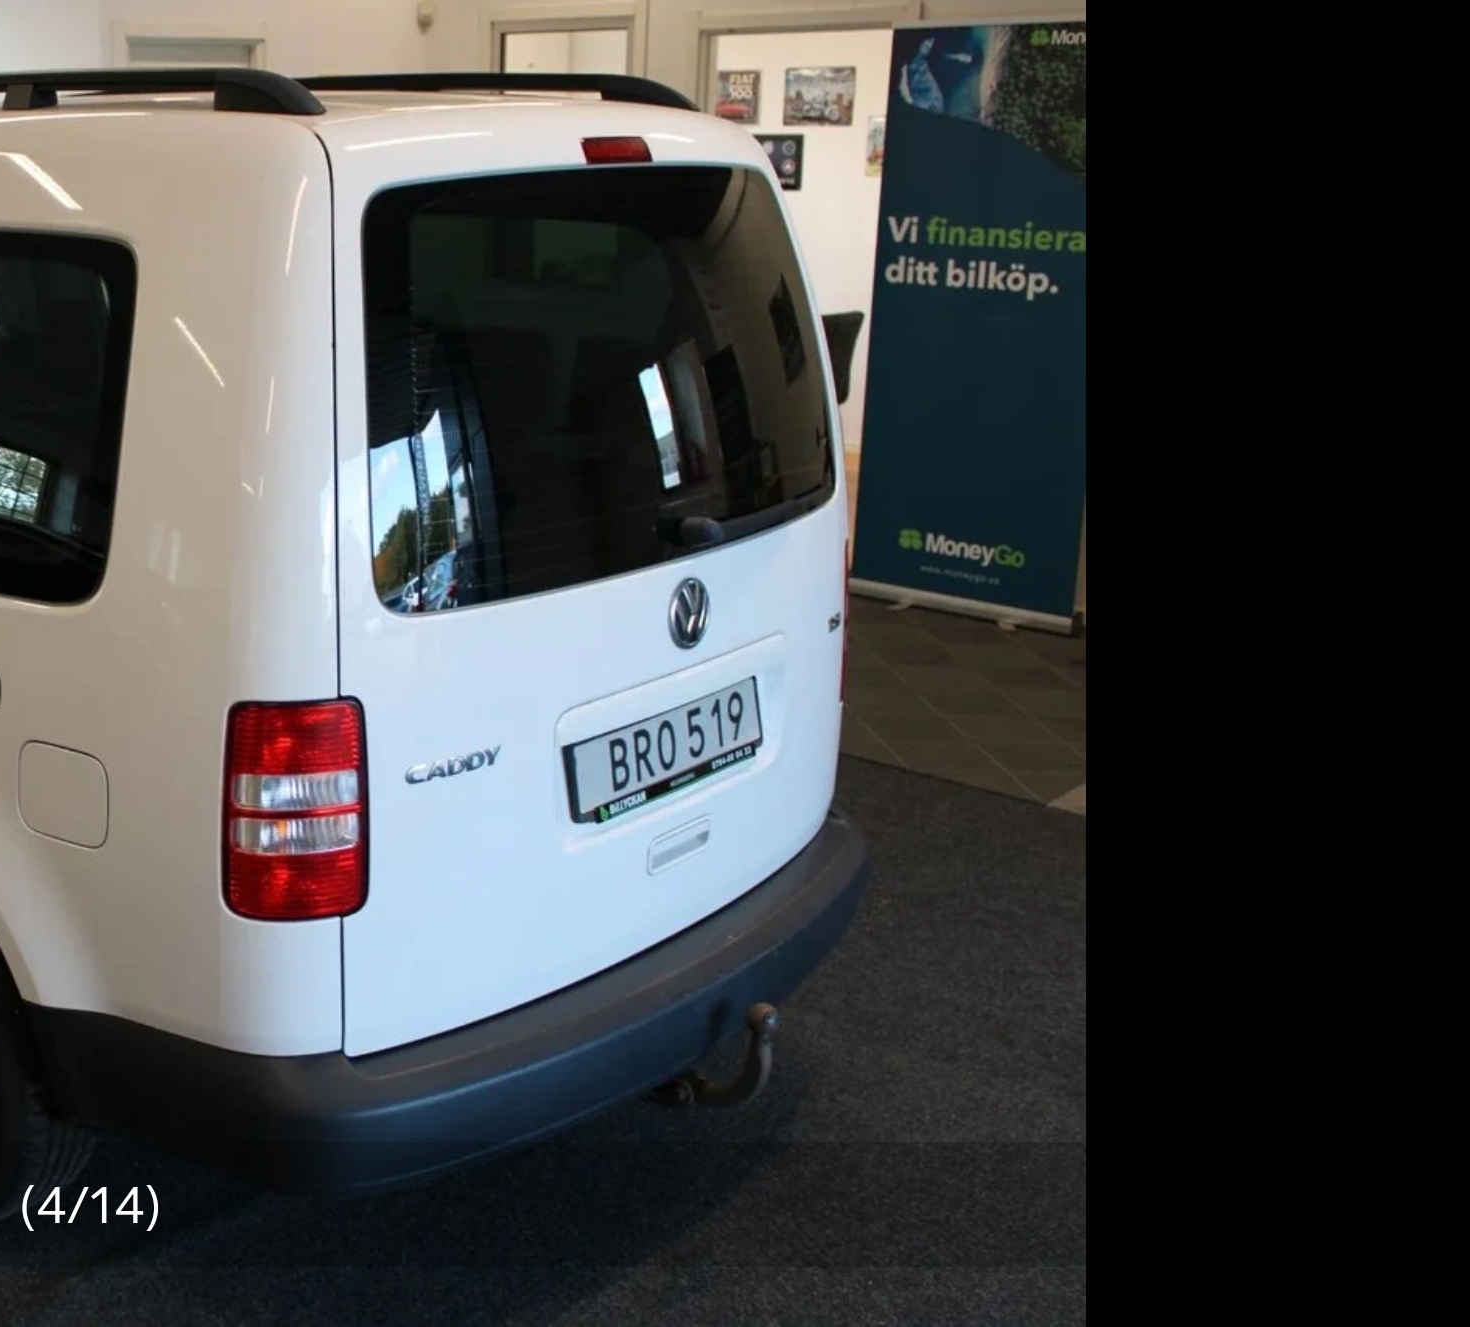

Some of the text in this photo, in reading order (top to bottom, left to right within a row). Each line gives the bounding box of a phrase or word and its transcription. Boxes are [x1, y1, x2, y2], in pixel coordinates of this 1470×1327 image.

[1051, 29, 1086, 45] Mon
[888, 215, 1086, 252] Vi finansiera
[884, 256, 1059, 301] ditt bilköp.
[925, 532, 1025, 568] MoneyGo
[609, 691, 743, 792] BRO 519
[405, 745, 501, 785] CADDY
